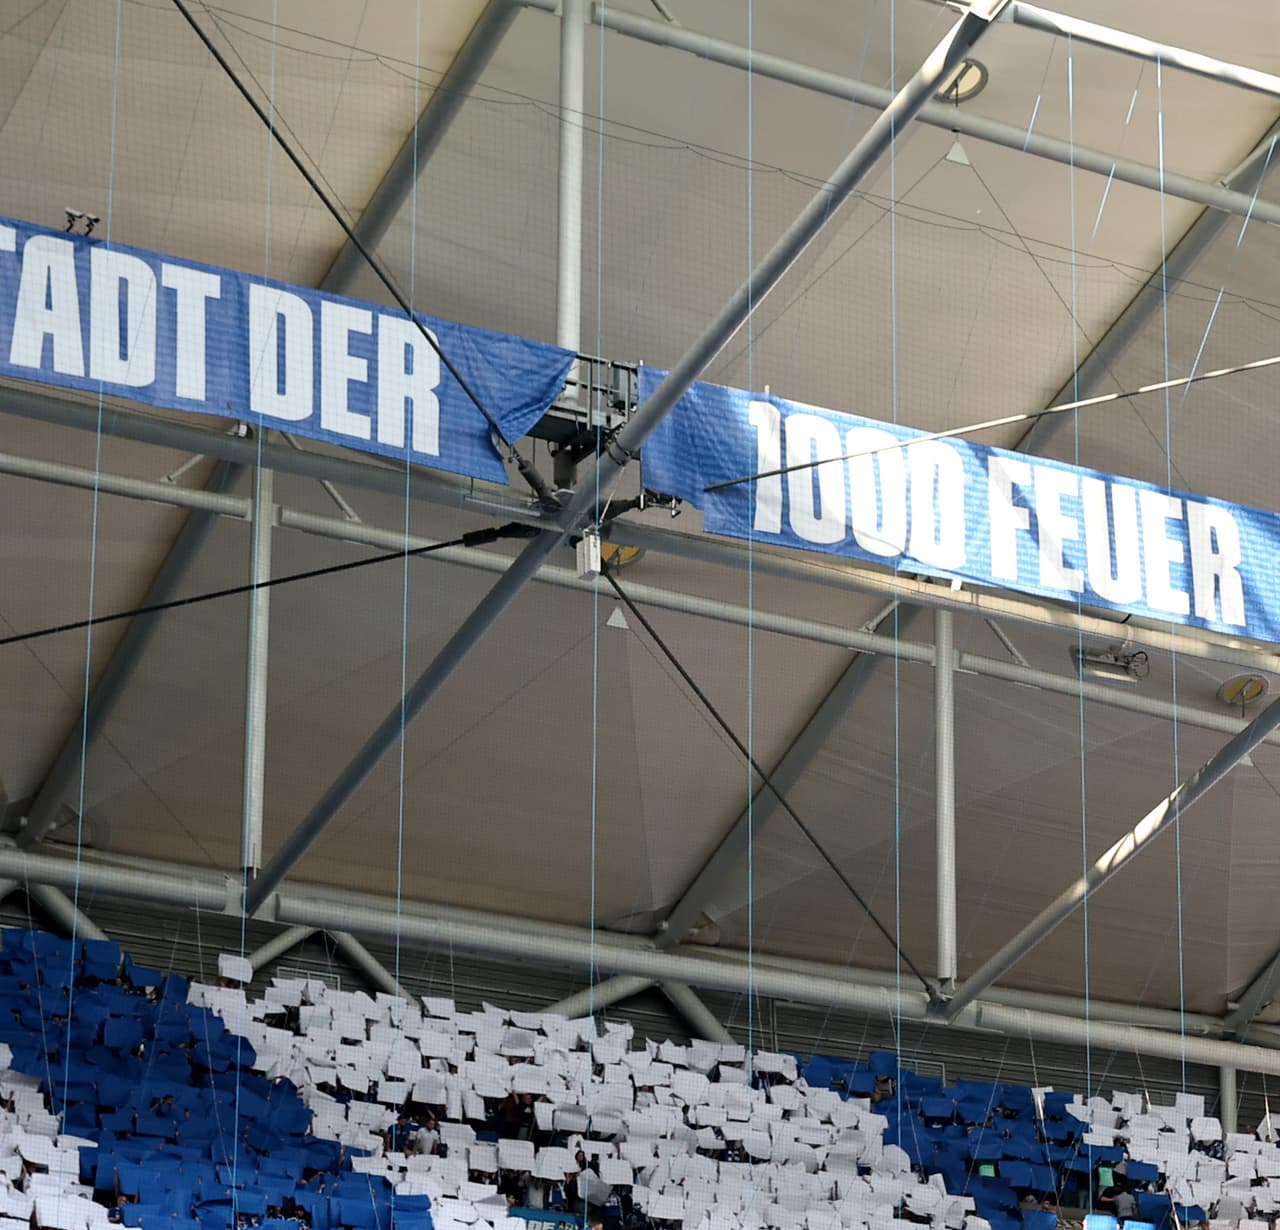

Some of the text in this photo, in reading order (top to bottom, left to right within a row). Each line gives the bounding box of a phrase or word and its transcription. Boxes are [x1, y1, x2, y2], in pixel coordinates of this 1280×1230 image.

[247, 283, 441, 457] DER
[748, 400, 1246, 627] 1000 FEUER
